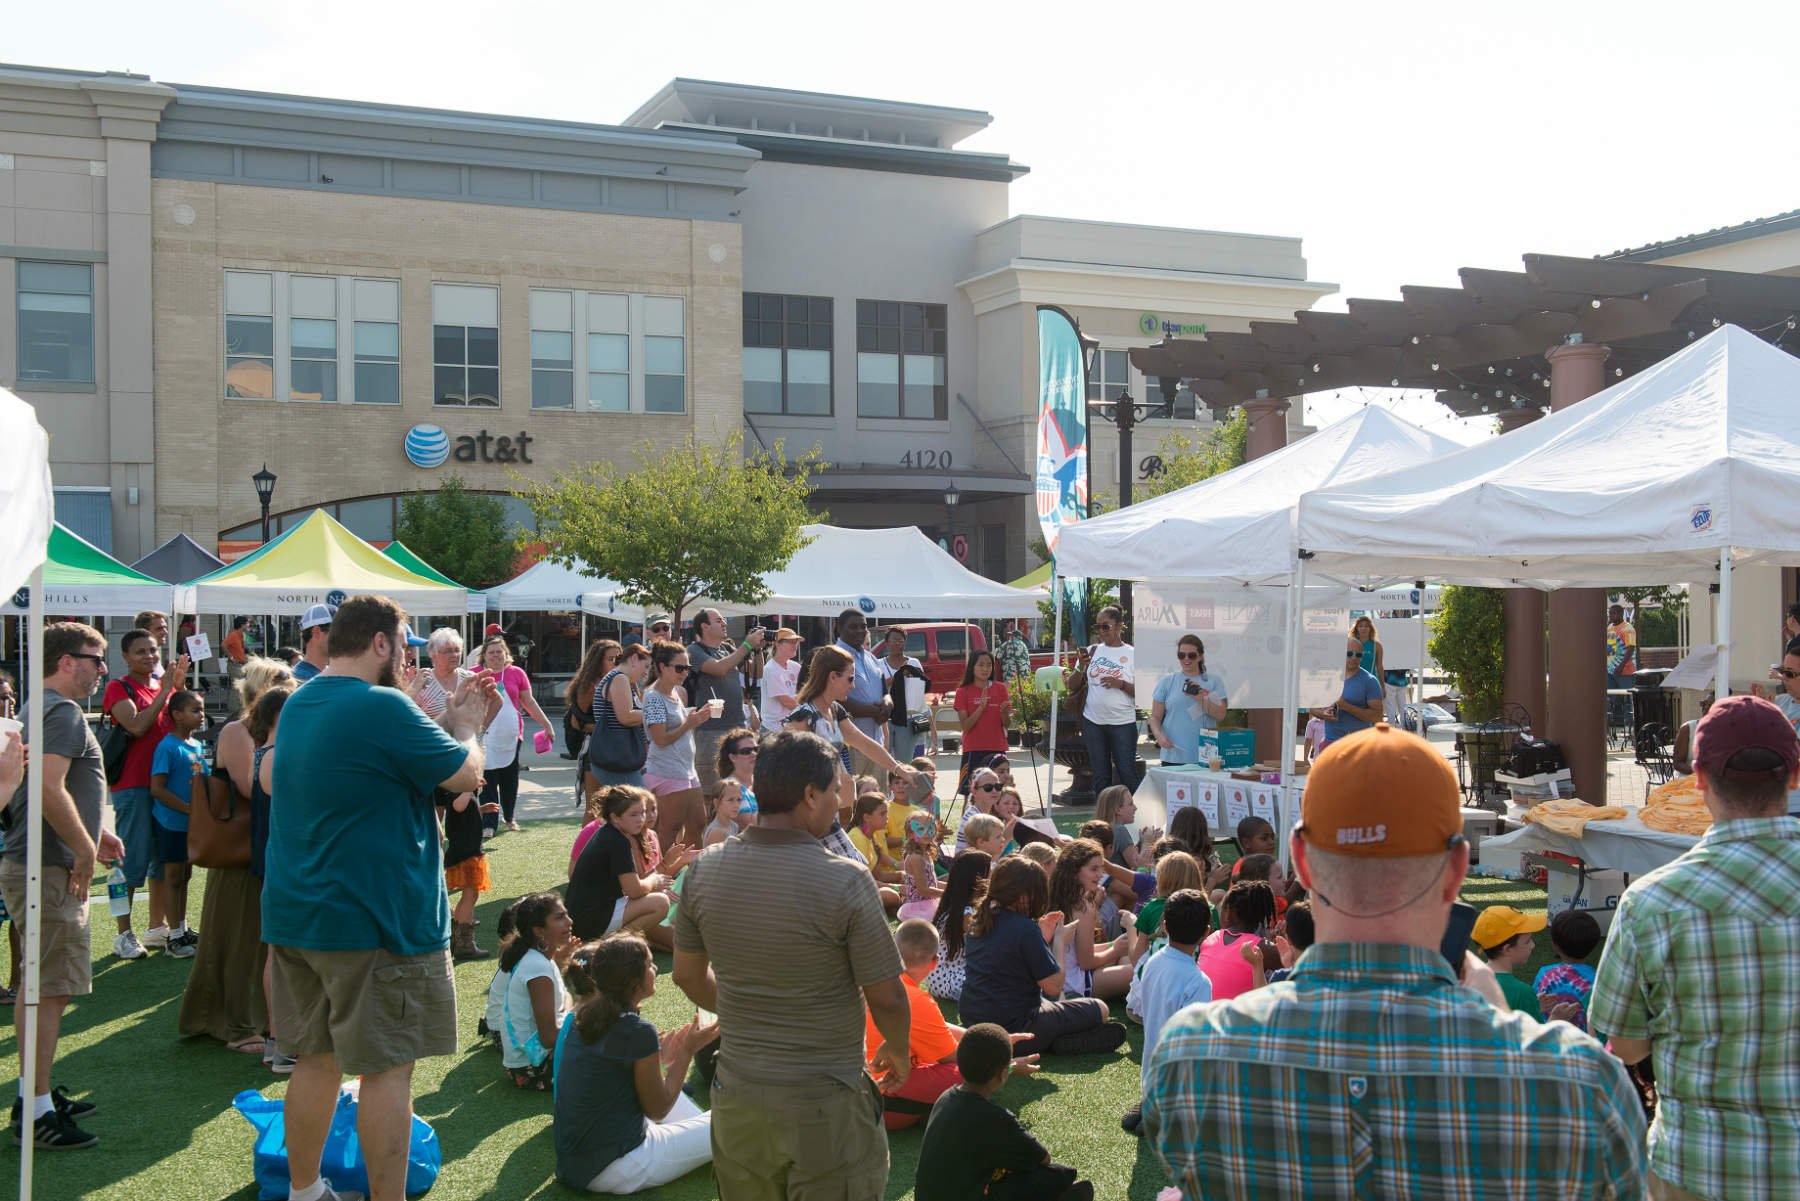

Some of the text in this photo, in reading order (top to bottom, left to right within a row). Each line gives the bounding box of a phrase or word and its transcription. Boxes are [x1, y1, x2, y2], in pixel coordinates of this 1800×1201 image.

[455, 429, 533, 464] at&t
[900, 449, 952, 470] 4120
[45, 594, 88, 603] HILLS
[277, 595, 318, 603] NORTH
[1381, 593, 1406, 601] NORTH
[822, 599, 854, 607] NORTH
[881, 600, 912, 609] HILLS
[1336, 824, 1387, 845] BULLS
